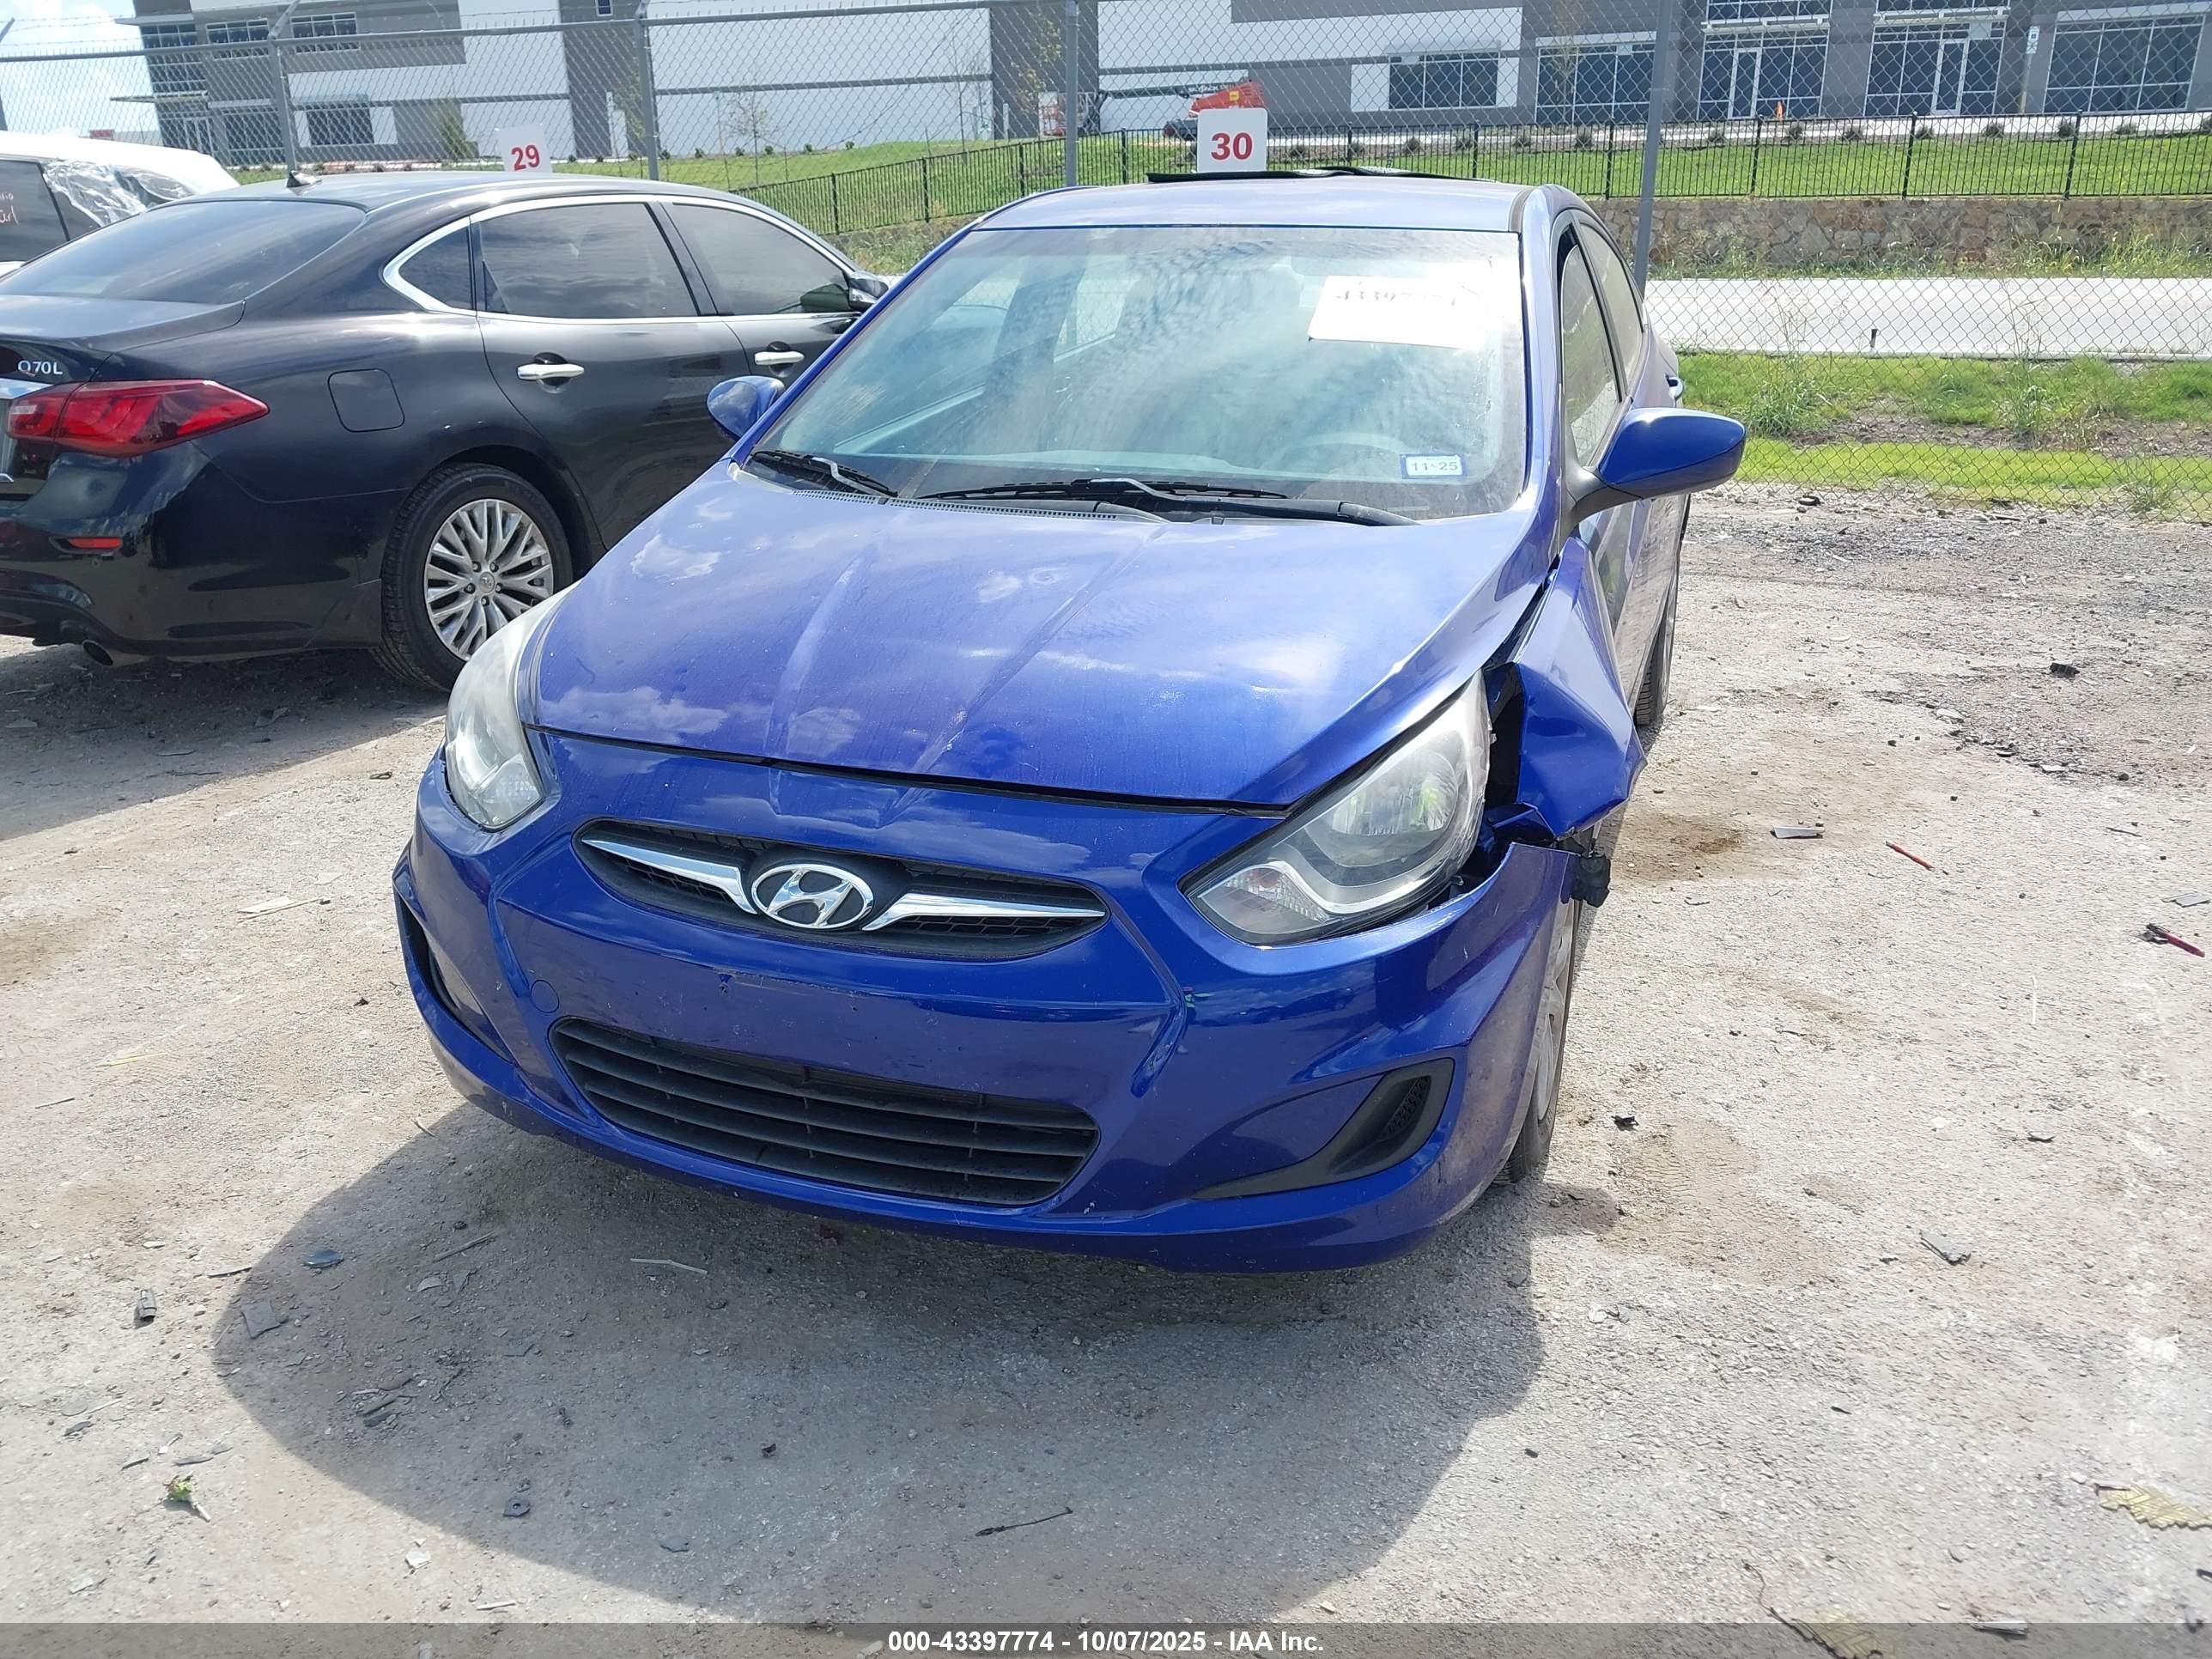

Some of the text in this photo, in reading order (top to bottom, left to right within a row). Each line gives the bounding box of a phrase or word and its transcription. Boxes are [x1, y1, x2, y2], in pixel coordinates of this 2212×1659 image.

[511, 144, 540, 171] 29
[1211, 132, 1253, 161] 30
[17, 360, 63, 377] Q70L
